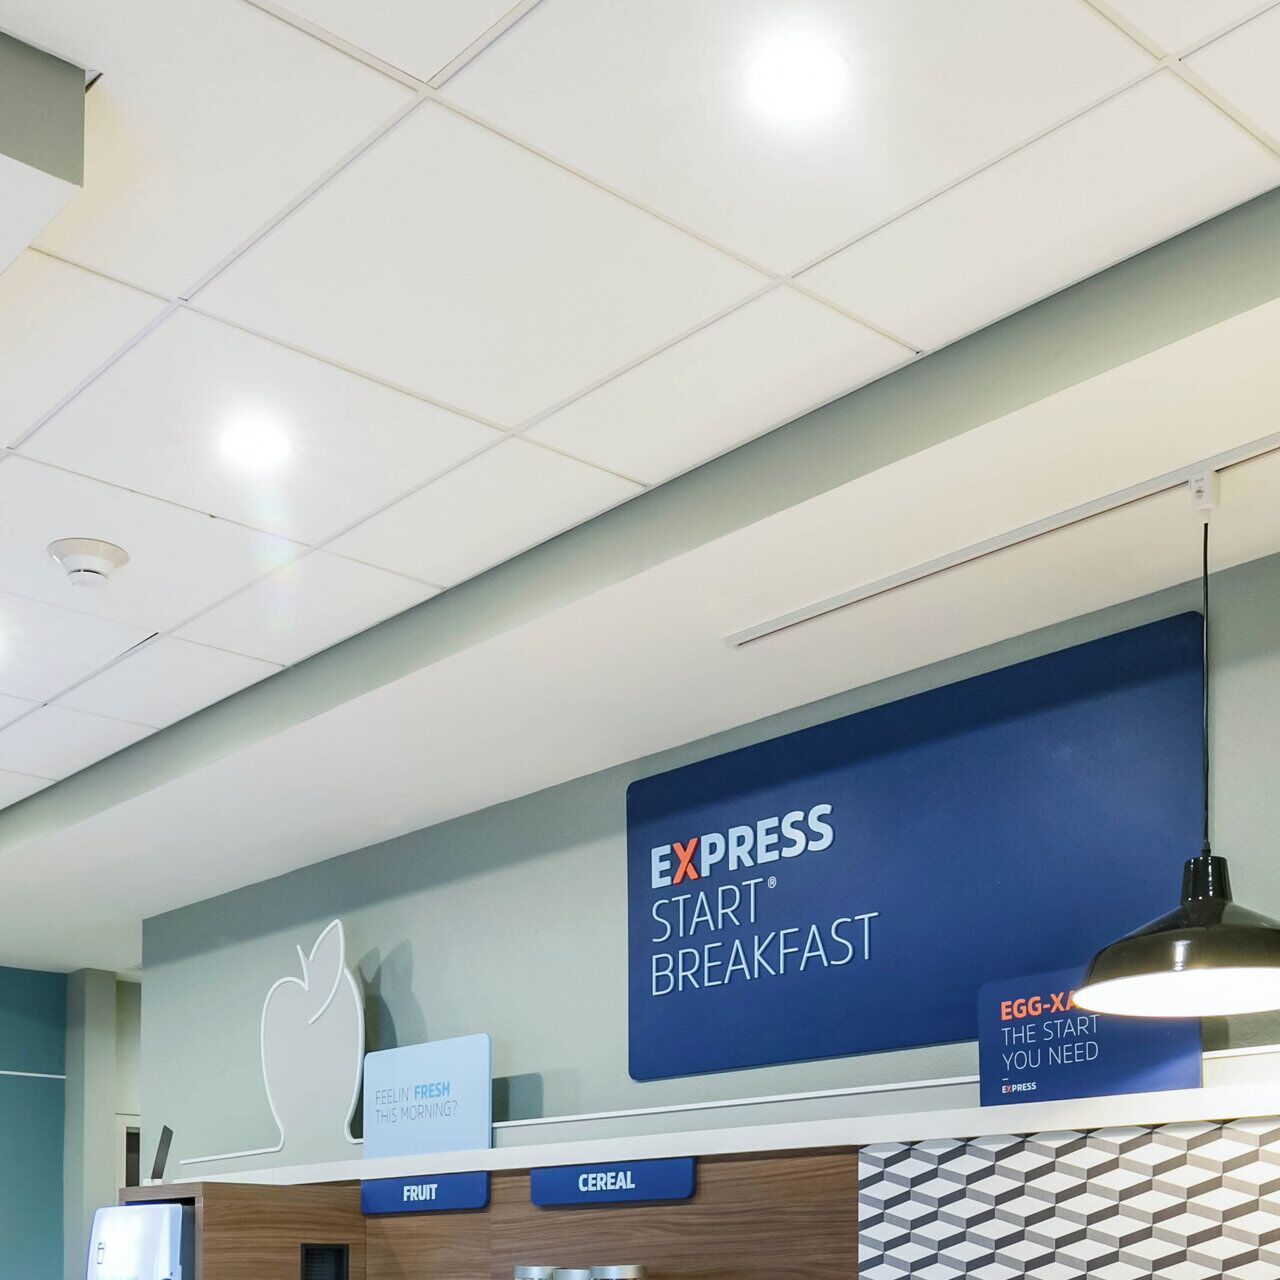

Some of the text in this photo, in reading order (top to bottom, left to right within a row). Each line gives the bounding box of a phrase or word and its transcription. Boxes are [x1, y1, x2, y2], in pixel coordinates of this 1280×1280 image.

[651, 804, 835, 889] EXPRESS
[652, 912, 880, 996] BREAKFAST
[1001, 1014, 1101, 1047] THE START
[1002, 1041, 1099, 1071] YOU NEED
[414, 1081, 451, 1100] FRESH
[1001, 1082, 1037, 1094] EXPRESS
[375, 1100, 458, 1125] THIS MORNING?
[403, 1183, 439, 1202] FRUIT
[578, 1171, 636, 1192] CEREAL
